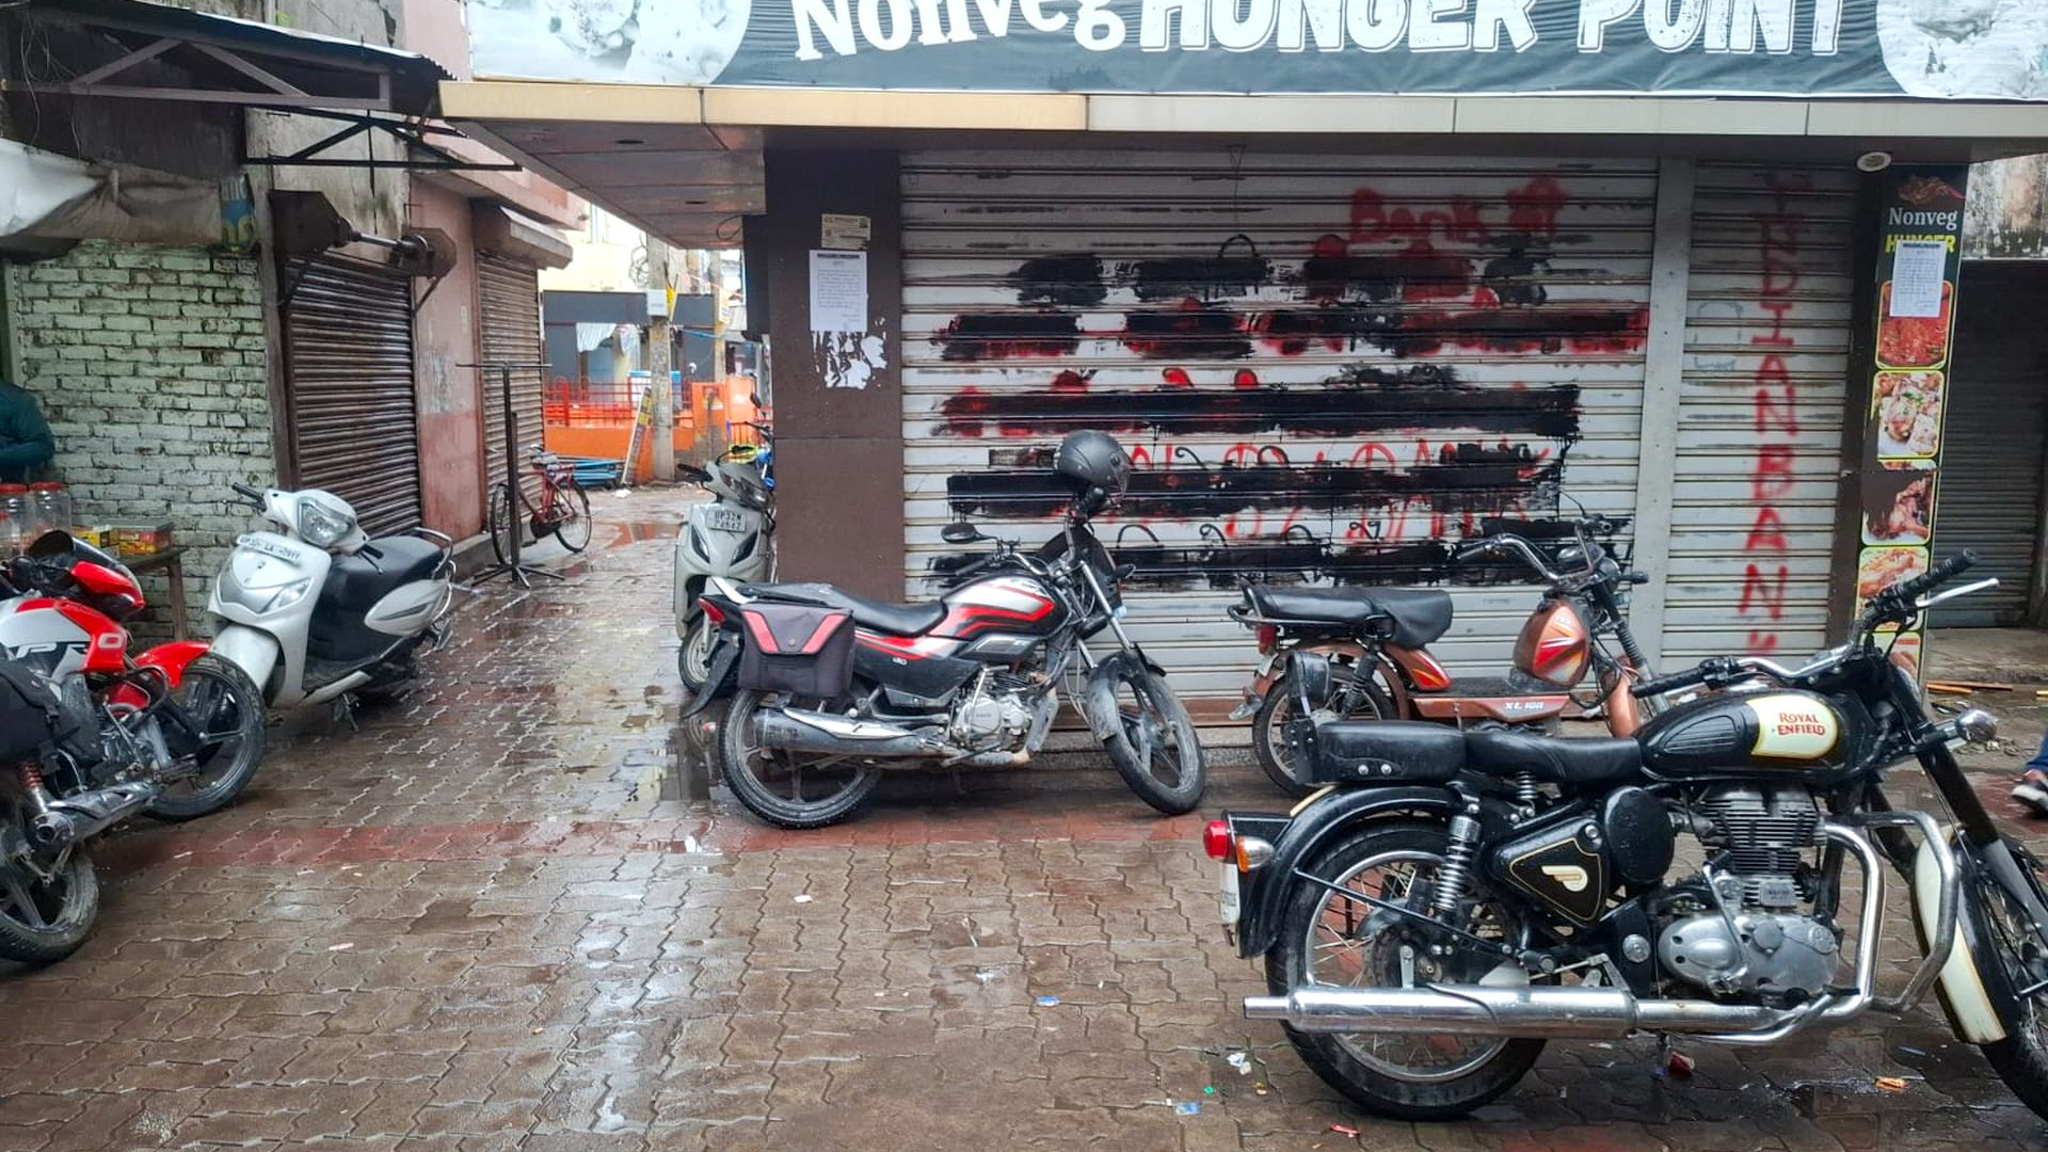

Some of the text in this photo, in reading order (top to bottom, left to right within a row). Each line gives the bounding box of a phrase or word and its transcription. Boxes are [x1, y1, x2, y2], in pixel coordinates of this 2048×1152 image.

[1139, 0, 1539, 53] HUNGER
[1888, 206, 1958, 231] Nonveg
[1779, 712, 1820, 723] ROYAL
[1777, 724, 1826, 736] ENFIELD
